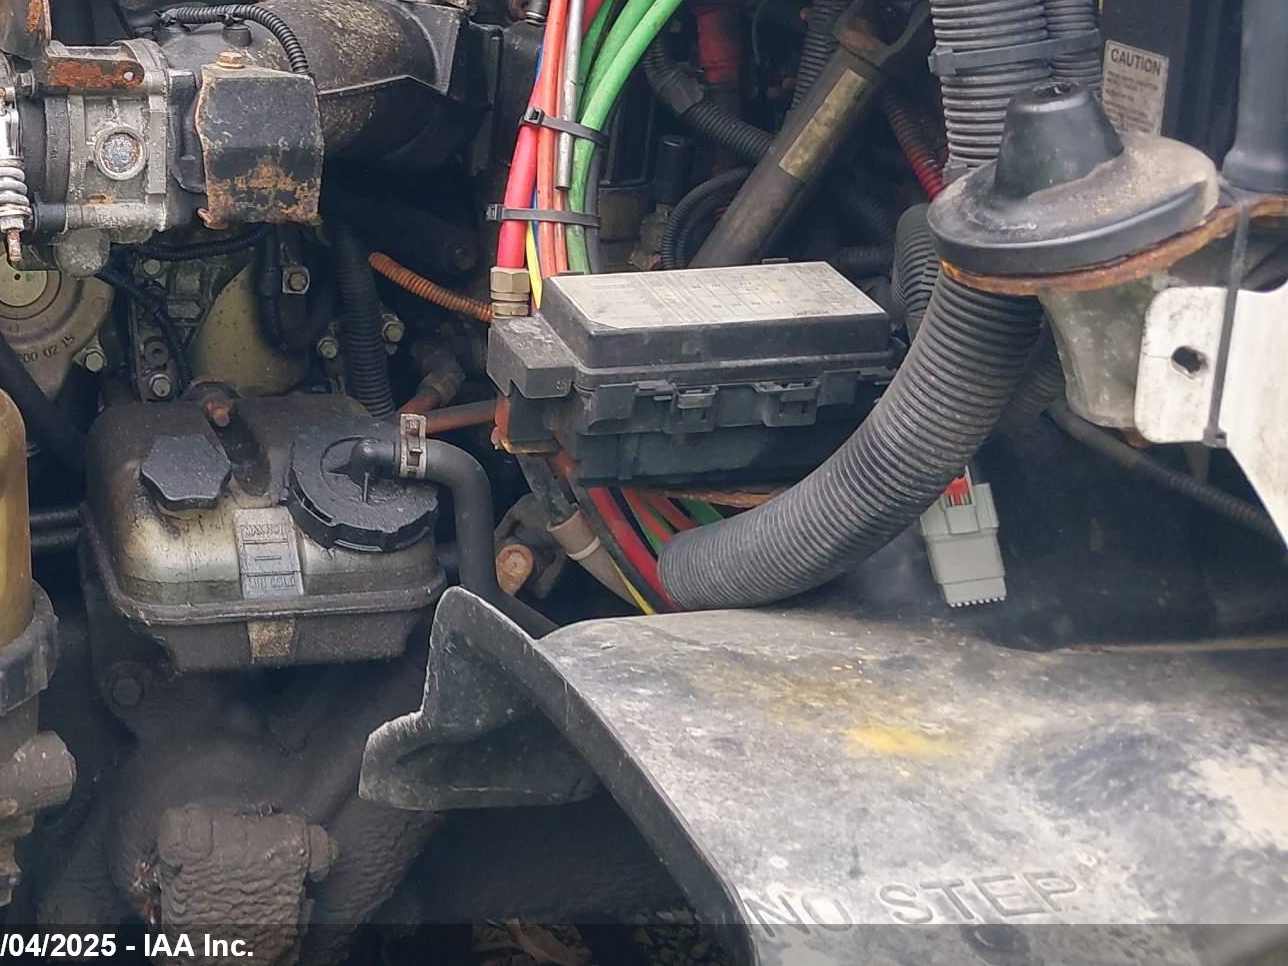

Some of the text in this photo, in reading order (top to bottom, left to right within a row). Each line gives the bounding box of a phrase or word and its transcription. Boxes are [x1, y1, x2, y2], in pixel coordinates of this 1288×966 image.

[1111, 48, 1161, 76] CAUTION
[742, 872, 1079, 938] NO STEP
